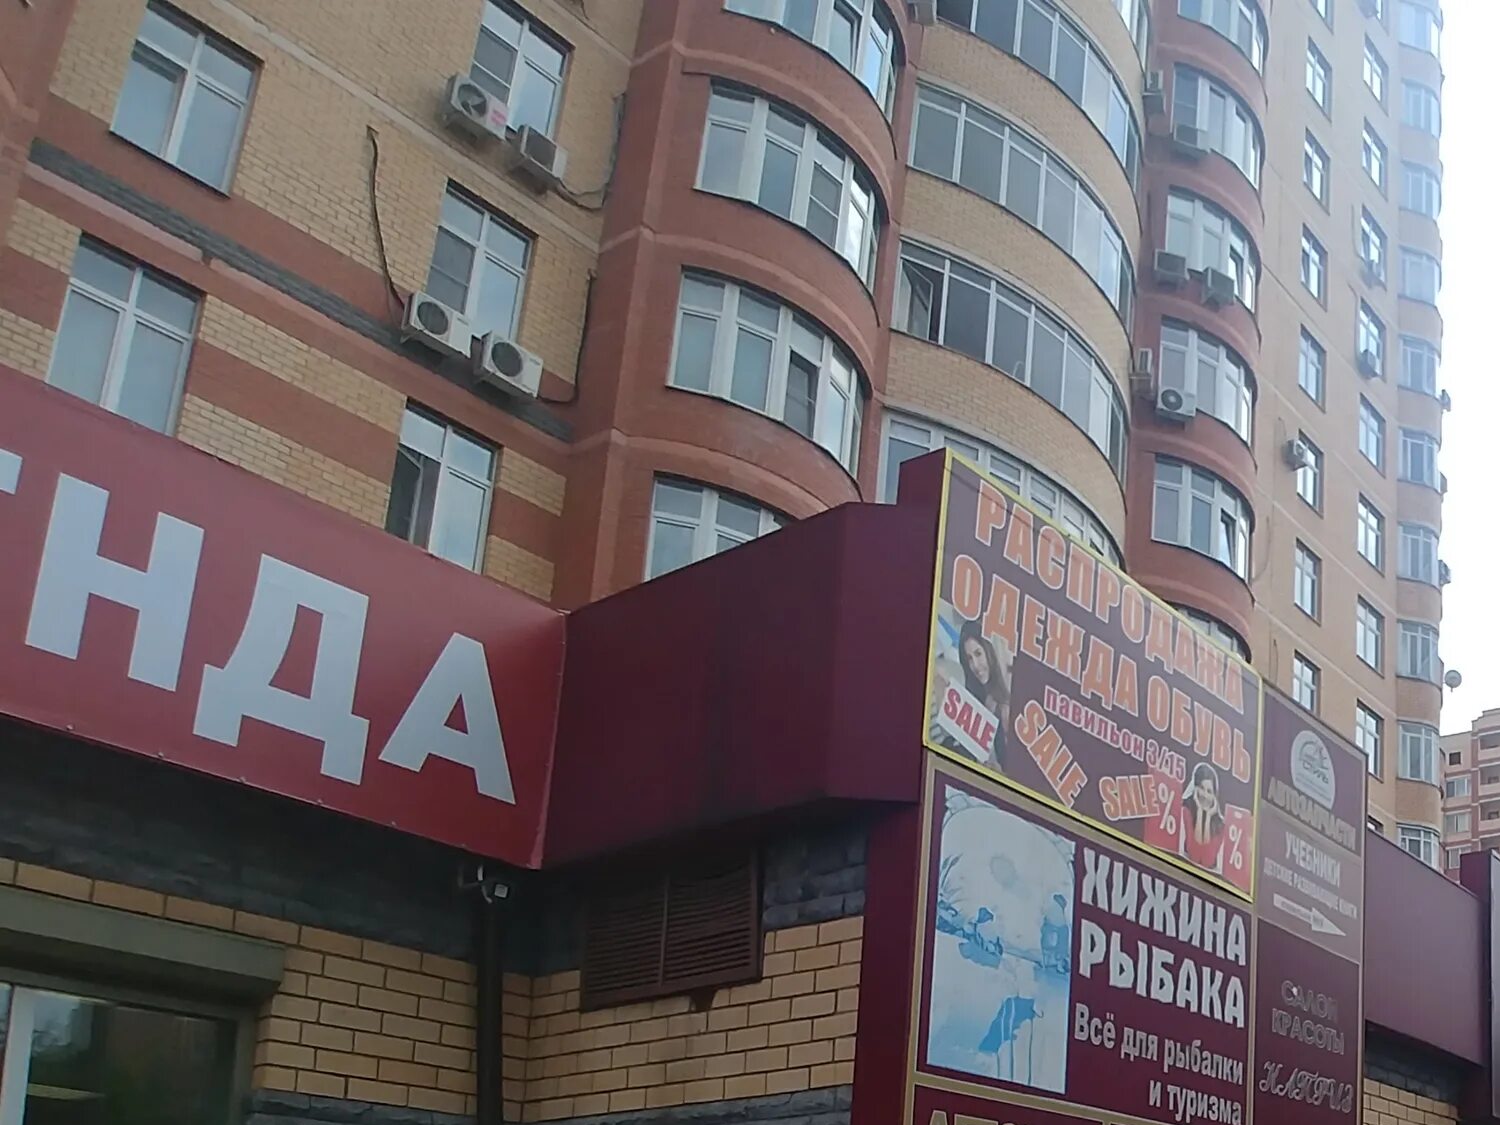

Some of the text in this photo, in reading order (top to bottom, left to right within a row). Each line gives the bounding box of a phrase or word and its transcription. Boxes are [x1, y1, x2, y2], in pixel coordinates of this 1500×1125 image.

[0, 450, 516, 805] НДА
[975, 478, 1245, 715] РАСПРОДАЖА
[951, 554, 1250, 783] ОДЕЖДА ОБУВЬ
[943, 687, 997, 753] SALE
[1014, 699, 1088, 809] SALE
[1044, 685, 1145, 761] павильон
[1099, 774, 1160, 821] SALE
[1267, 776, 1357, 850] АВТОЗАПЧАСТИ
[1286, 831, 1341, 888] УЧЕБНИКИ
[1081, 847, 1247, 966] ХИЖИНА
[1078, 918, 1245, 1029] РЫБАКА
[1281, 980, 1338, 1022] САЛОН
[1074, 1002, 1243, 1085] Всё для рыбалки
[1272, 1008, 1344, 1055] КРАСОТЫ
[1149, 1079, 1161, 1108] и
